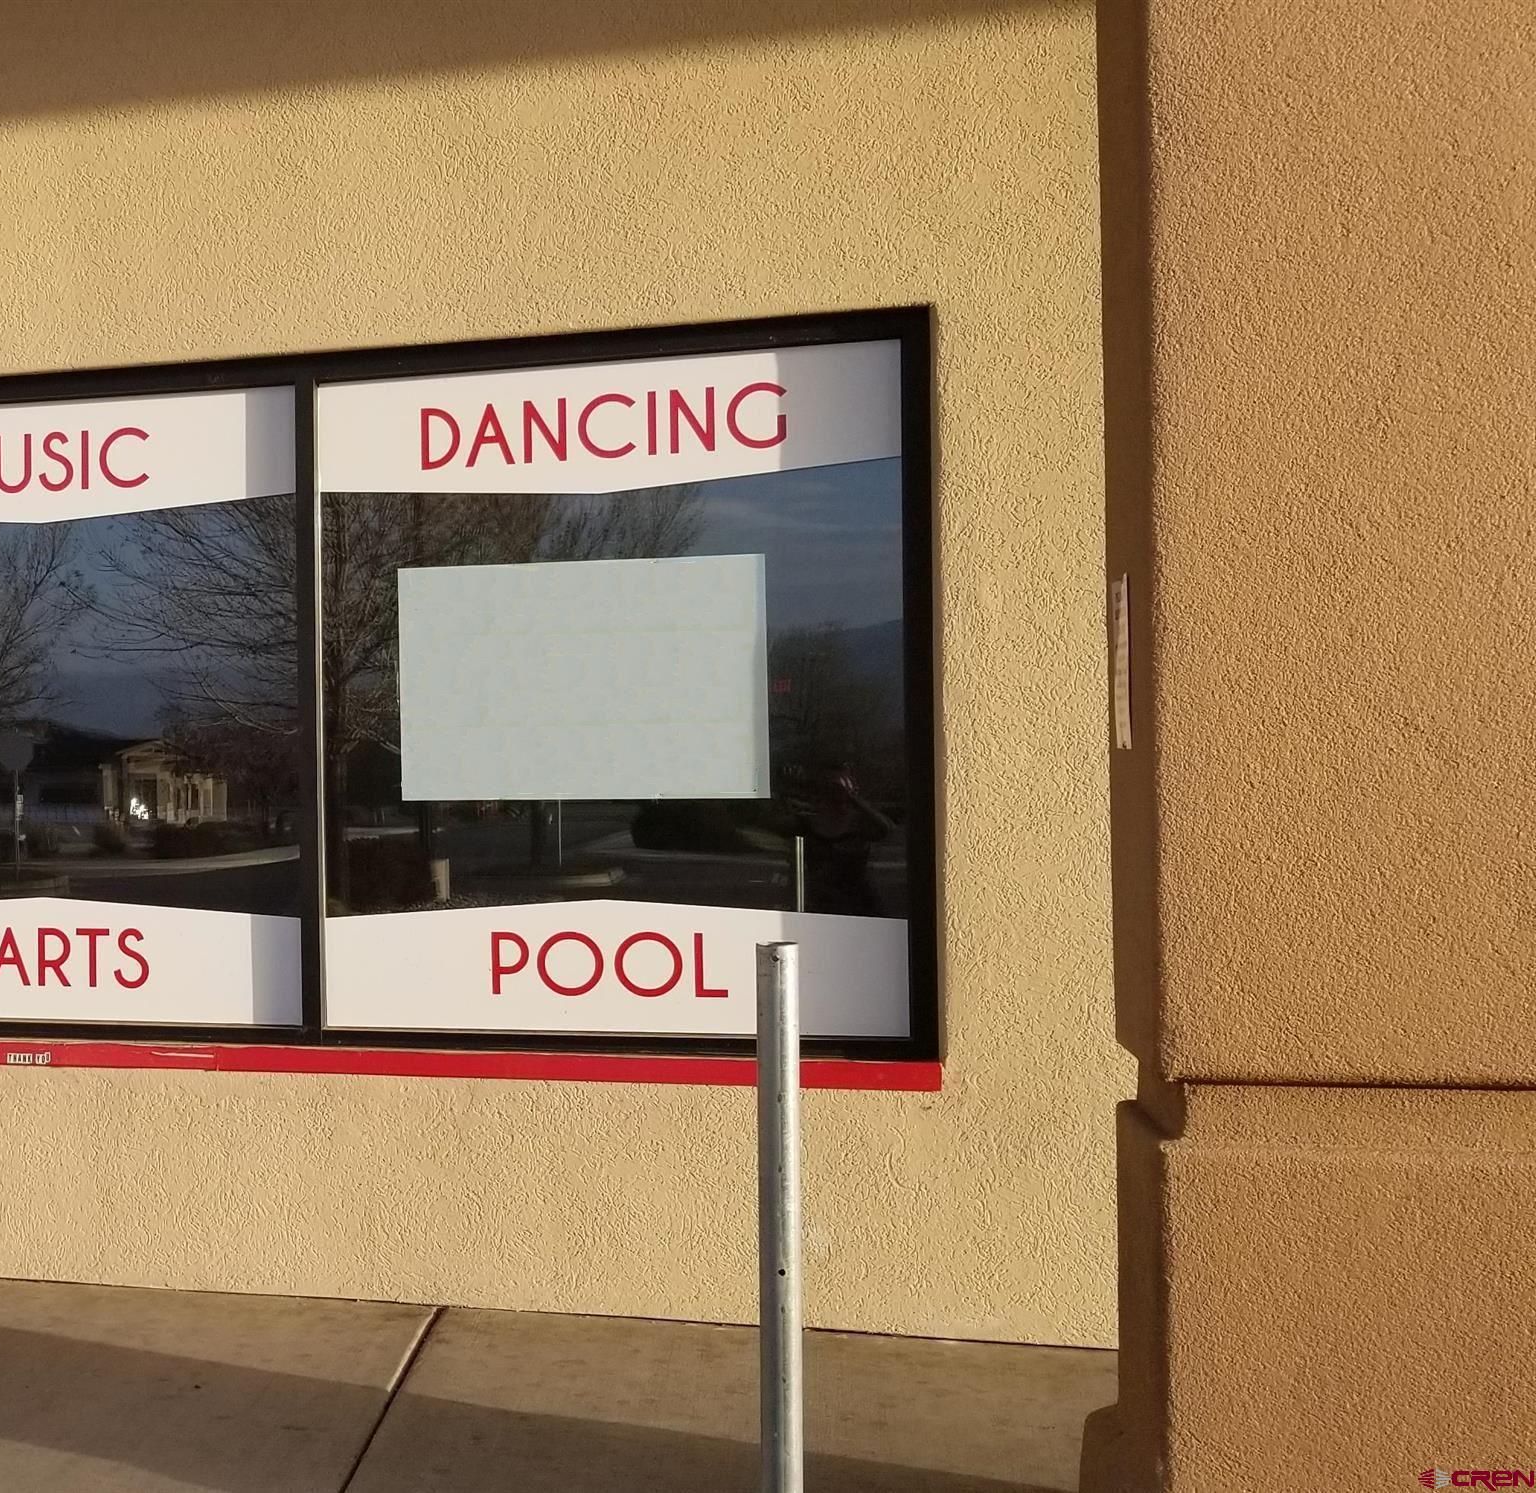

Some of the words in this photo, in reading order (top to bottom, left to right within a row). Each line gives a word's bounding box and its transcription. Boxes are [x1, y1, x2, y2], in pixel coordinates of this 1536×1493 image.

[420, 382, 786, 471] DANCING
[491, 931, 729, 998] POOL
[7, 1053, 32, 1063] THANK
[36, 1053, 50, 1064] YOU
